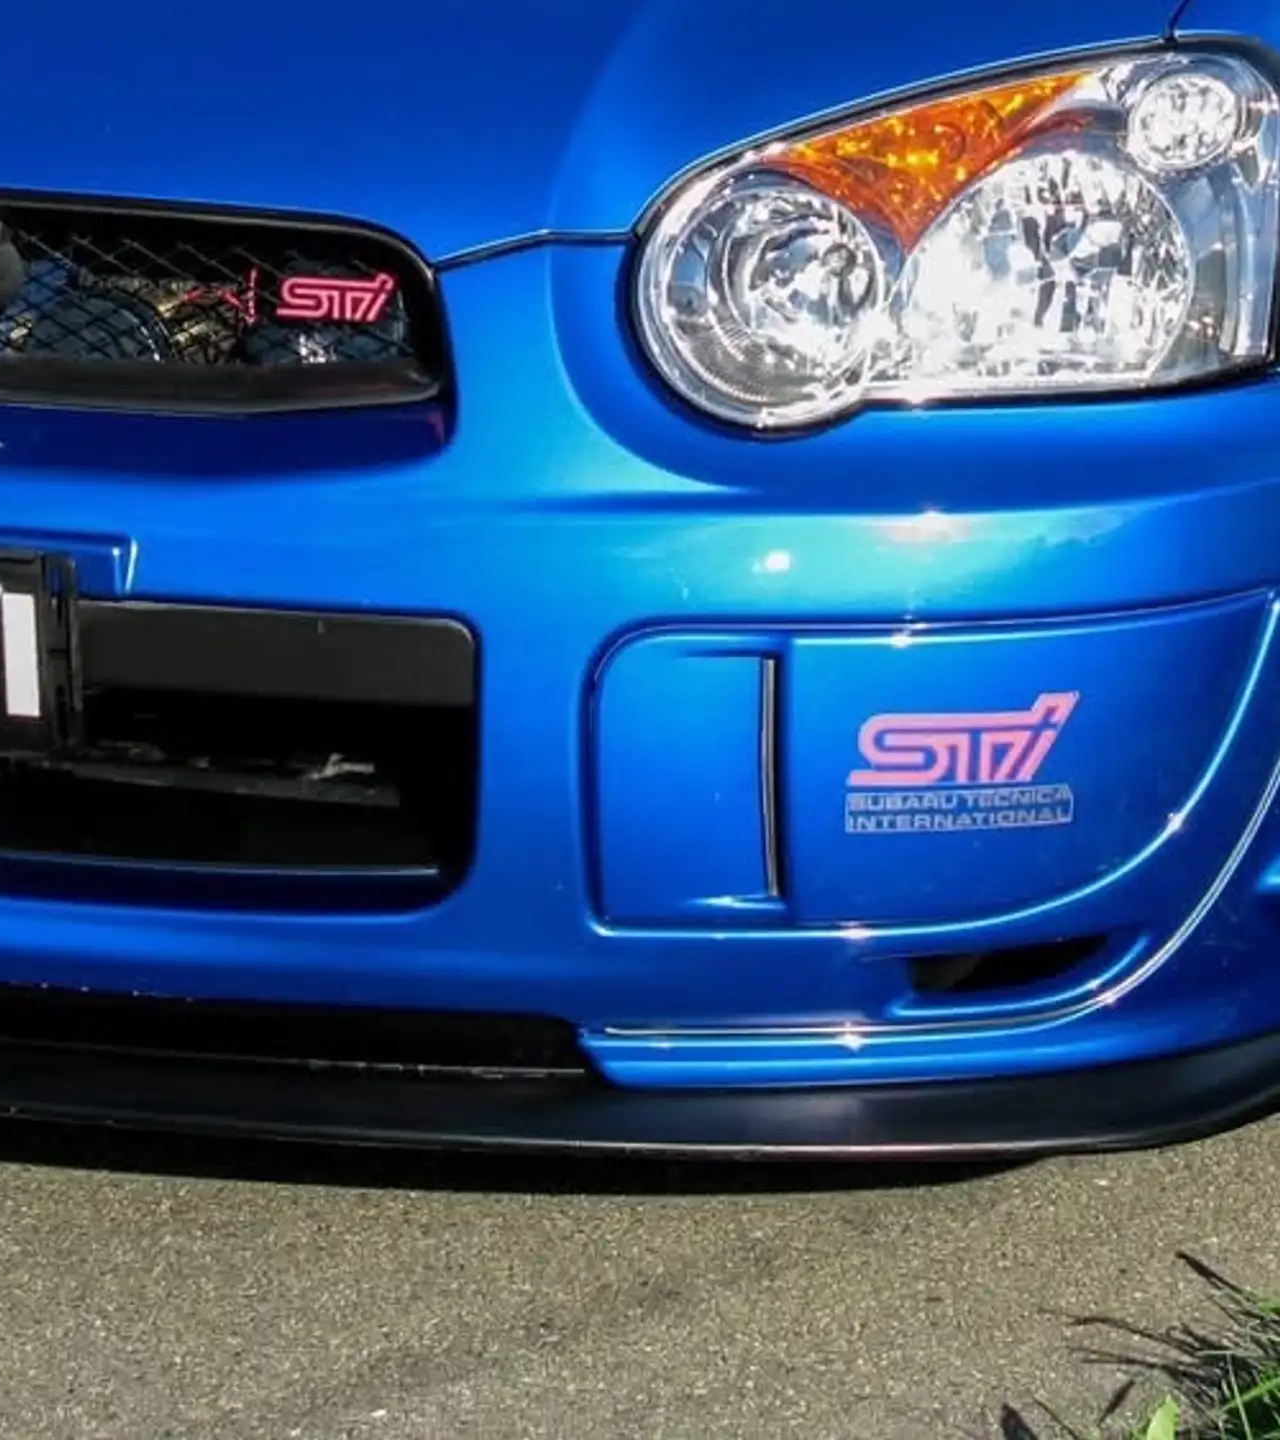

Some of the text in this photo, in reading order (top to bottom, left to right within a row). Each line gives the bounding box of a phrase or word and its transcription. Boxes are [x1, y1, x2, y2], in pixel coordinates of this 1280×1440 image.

[849, 786, 1072, 811] SUBARU TECNICA
[847, 807, 1071, 833] INTERNATIONAL
